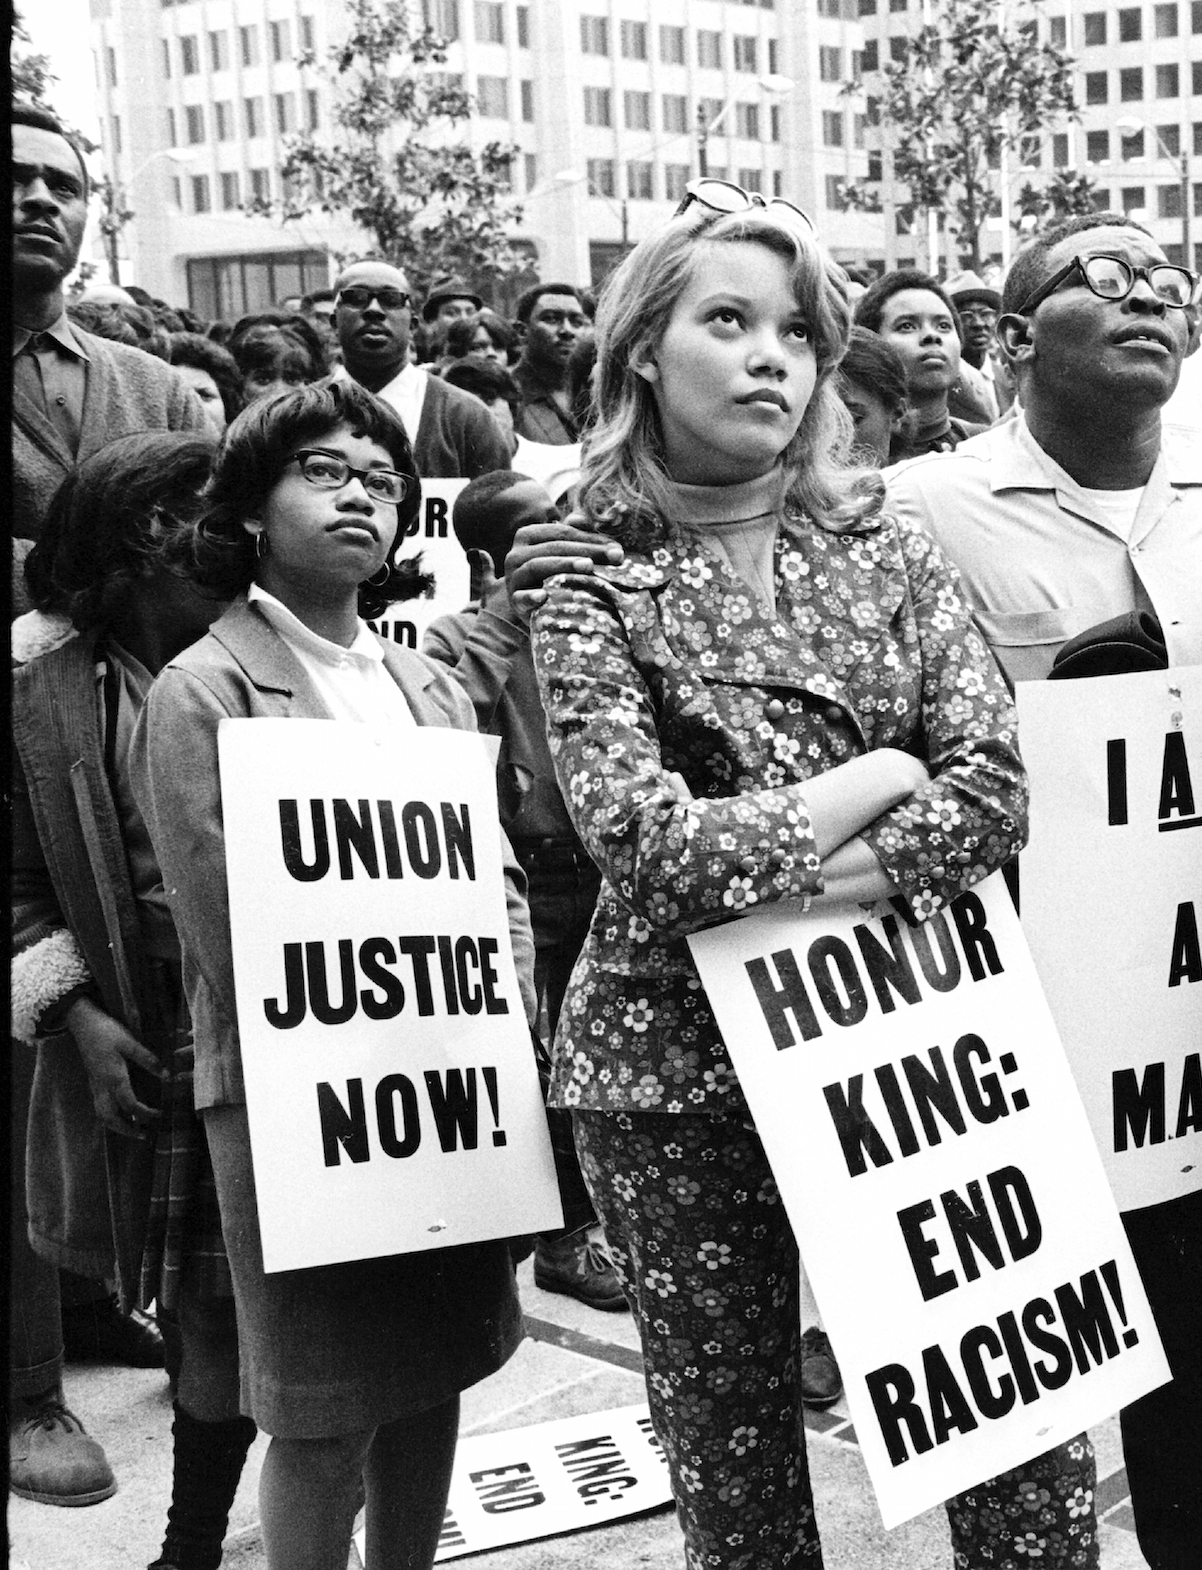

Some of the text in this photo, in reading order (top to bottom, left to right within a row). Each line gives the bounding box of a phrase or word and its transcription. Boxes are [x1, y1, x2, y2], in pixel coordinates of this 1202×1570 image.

[1106, 738, 1129, 827] I
[278, 798, 476, 883] UNION
[263, 935, 510, 1030] JUSTICE
[744, 891, 1005, 1051] HONOR
[316, 1066, 507, 1168] NOW!
[822, 1033, 1030, 1178] KING:
[896, 1165, 1042, 1302] END
[864, 1259, 1140, 1468] RACISM!
[468, 1462, 546, 1514] END
[554, 1435, 638, 1506] KING:
